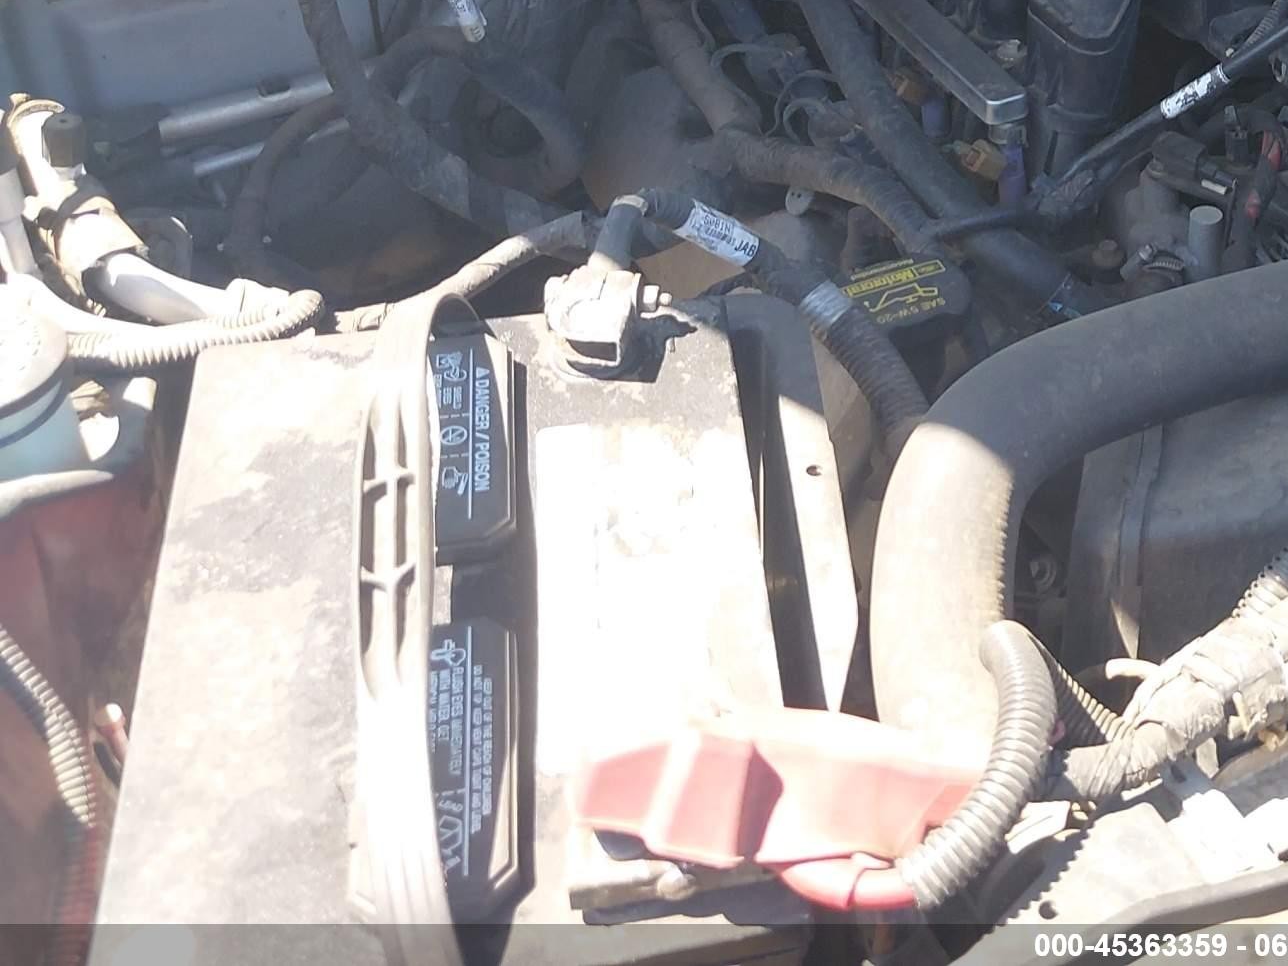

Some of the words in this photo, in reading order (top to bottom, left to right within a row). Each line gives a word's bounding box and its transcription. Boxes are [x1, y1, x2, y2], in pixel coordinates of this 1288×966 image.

[734, 239, 757, 258] JAB
[920, 297, 946, 312] SAE
[475, 379, 490, 430] DANGER
[475, 431, 490, 440] /
[475, 442, 490, 492] POISON
[439, 668, 451, 691] WITH
[452, 667, 464, 694] FLUSH
[451, 695, 464, 717] EYES
[450, 719, 463, 776] IMMEDIATELY
